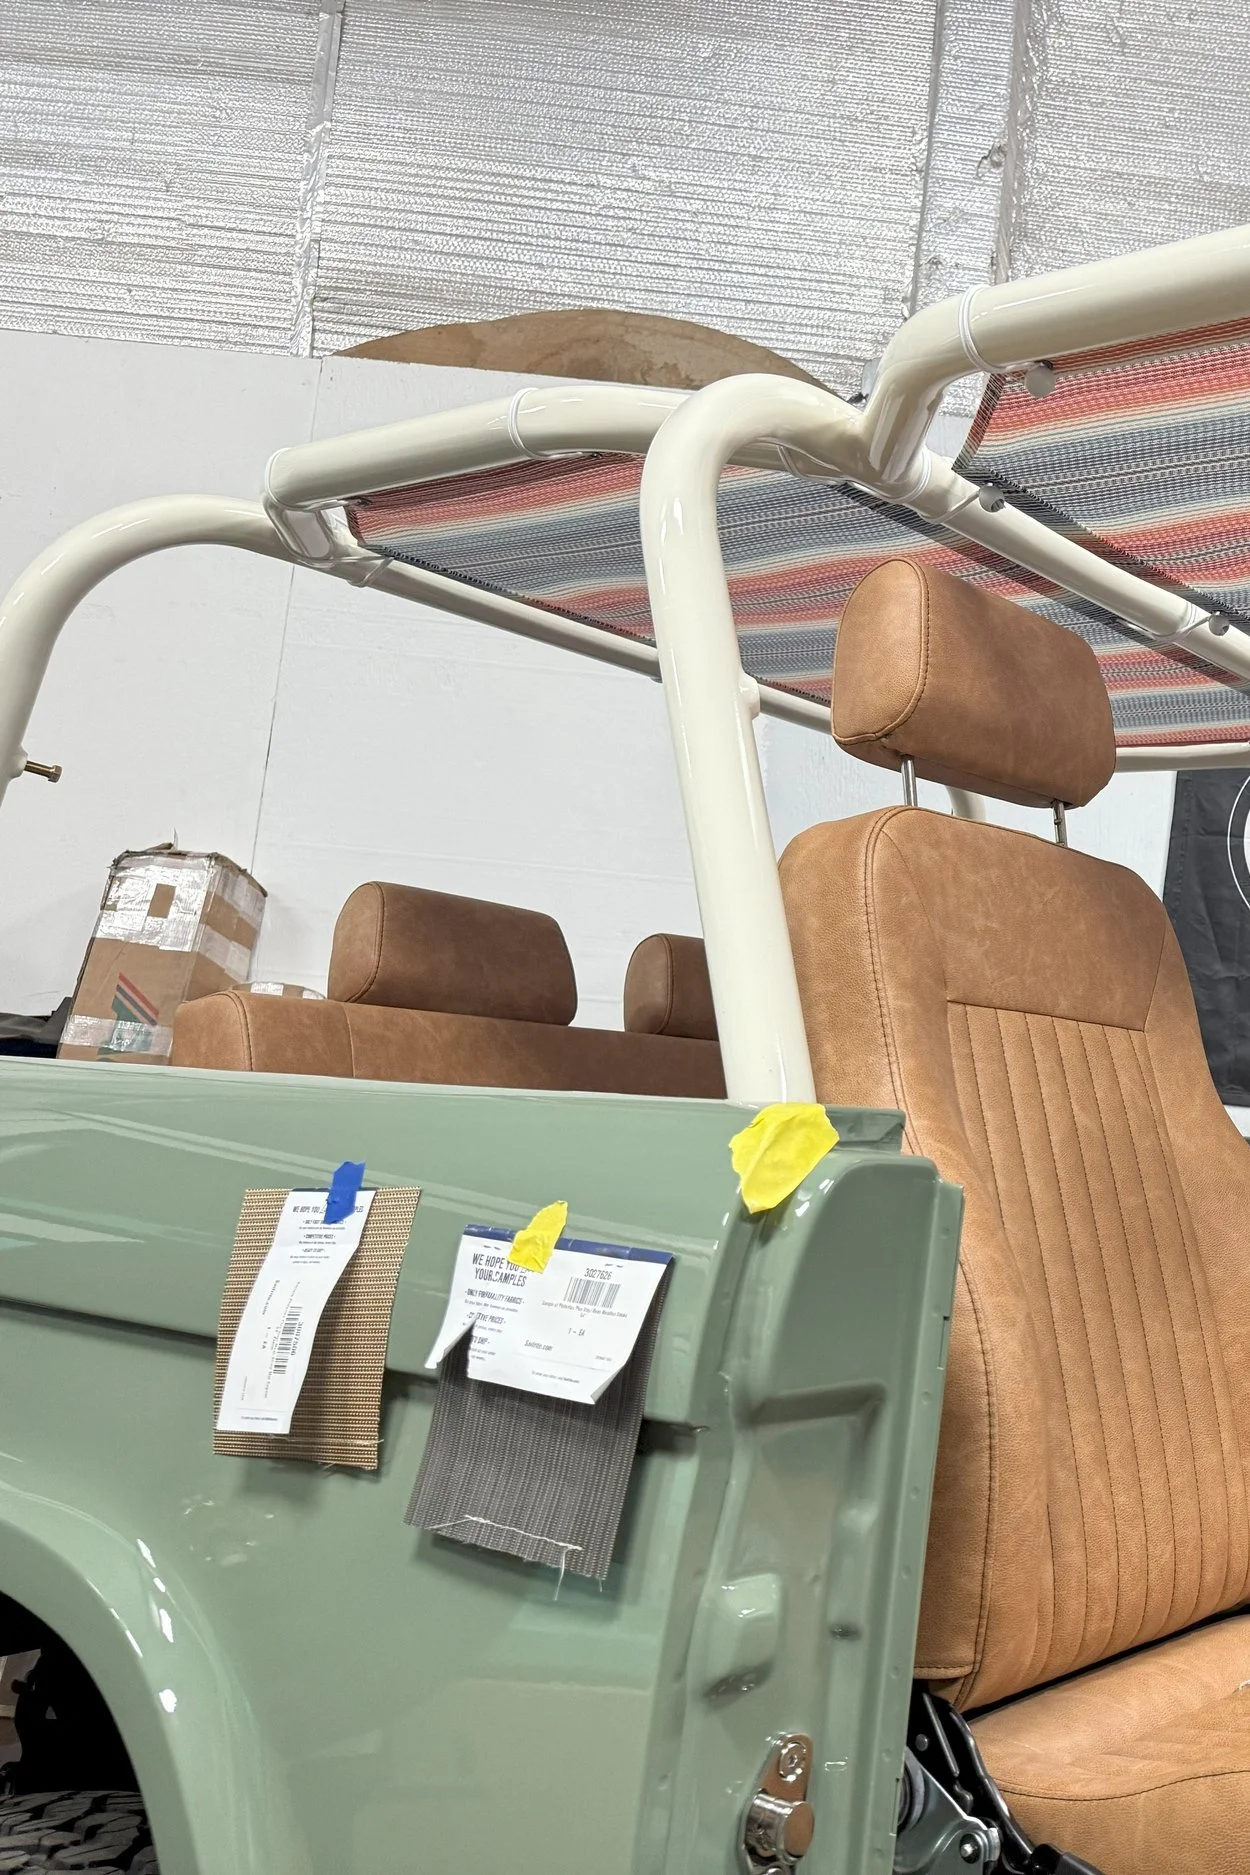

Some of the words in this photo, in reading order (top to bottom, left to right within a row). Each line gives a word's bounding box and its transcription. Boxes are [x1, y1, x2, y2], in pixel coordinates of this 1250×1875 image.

[472, 1252, 484, 1266] WE
[484, 1255, 506, 1269] HOPE
[474, 1268, 493, 1281] YOUR
[491, 1272, 528, 1287] SAMPLES
